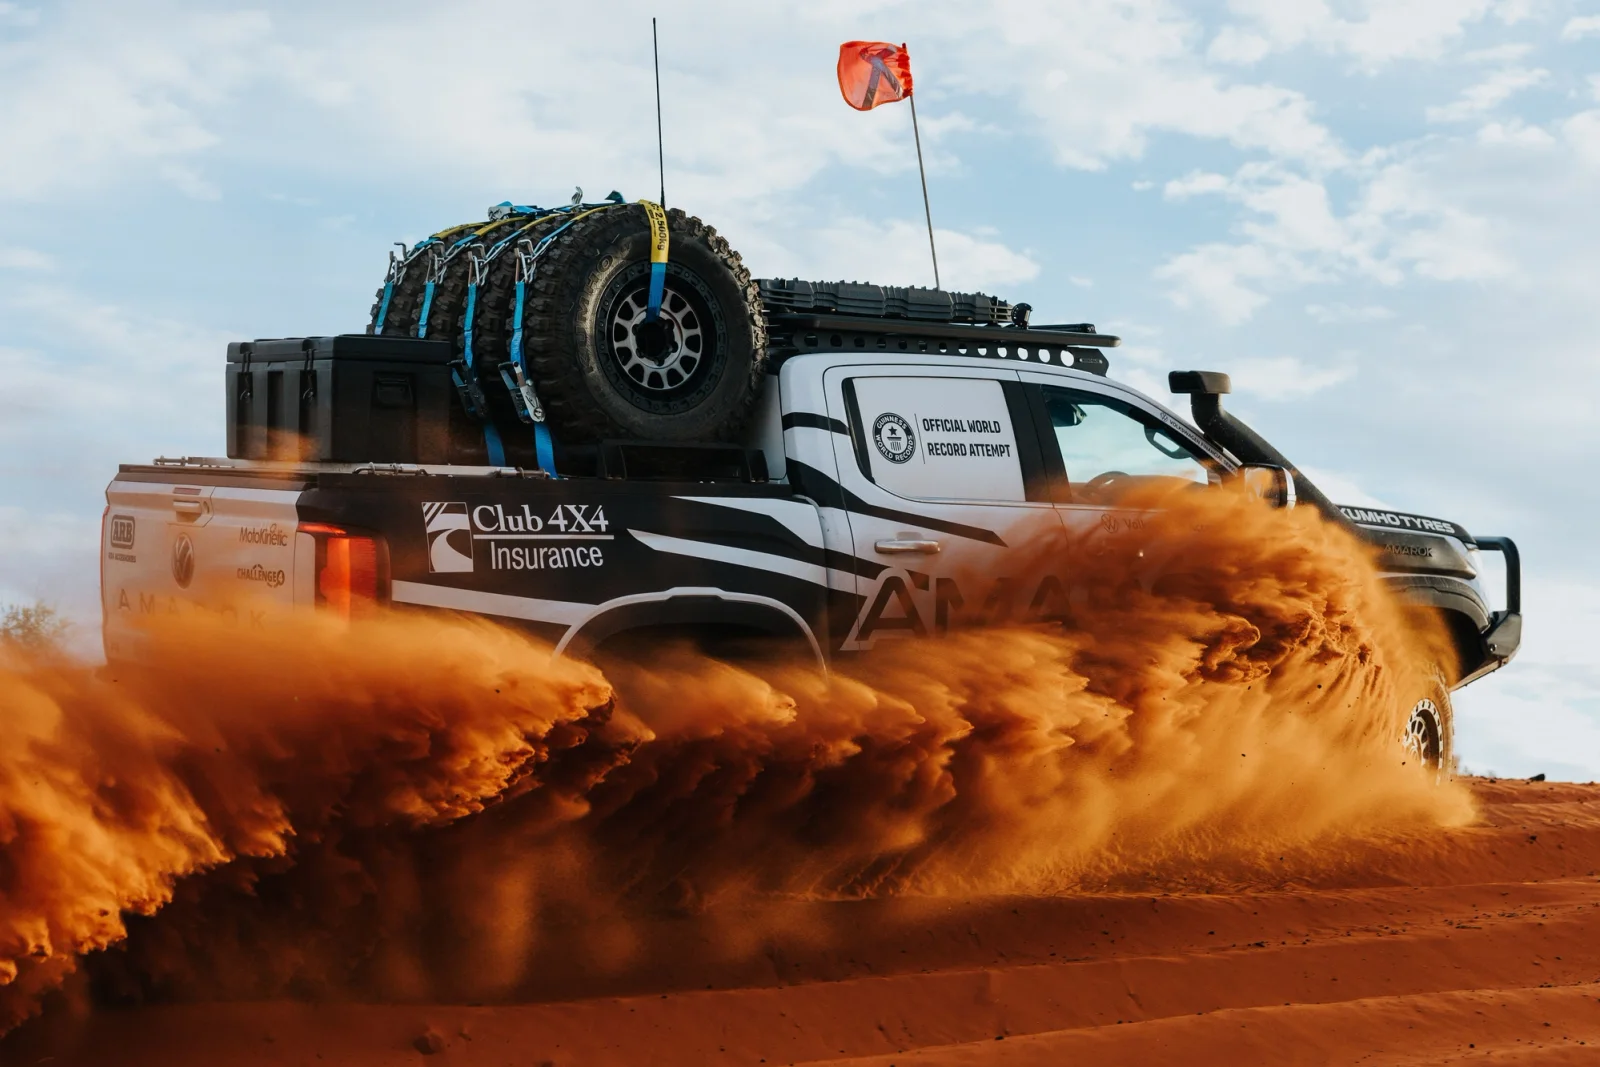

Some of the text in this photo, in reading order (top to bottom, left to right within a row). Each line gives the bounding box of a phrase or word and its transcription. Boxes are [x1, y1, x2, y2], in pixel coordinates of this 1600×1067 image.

[876, 415, 908, 430] GUINNESS
[922, 418, 1001, 433] OFFICIAL WORLD
[1169, 419, 1201, 446] VOLKSWAGEN
[875, 434, 914, 461] WORLD RECORDS
[927, 442, 1010, 457] RECORD ATTEMPT
[472, 504, 609, 532] Club 4X4
[1399, 515, 1455, 534] TYRES
[112, 520, 133, 543] ARB
[239, 526, 288, 546] MotoKinetic
[490, 541, 604, 570] Insurance
[1384, 544, 1433, 557] AMAROK
